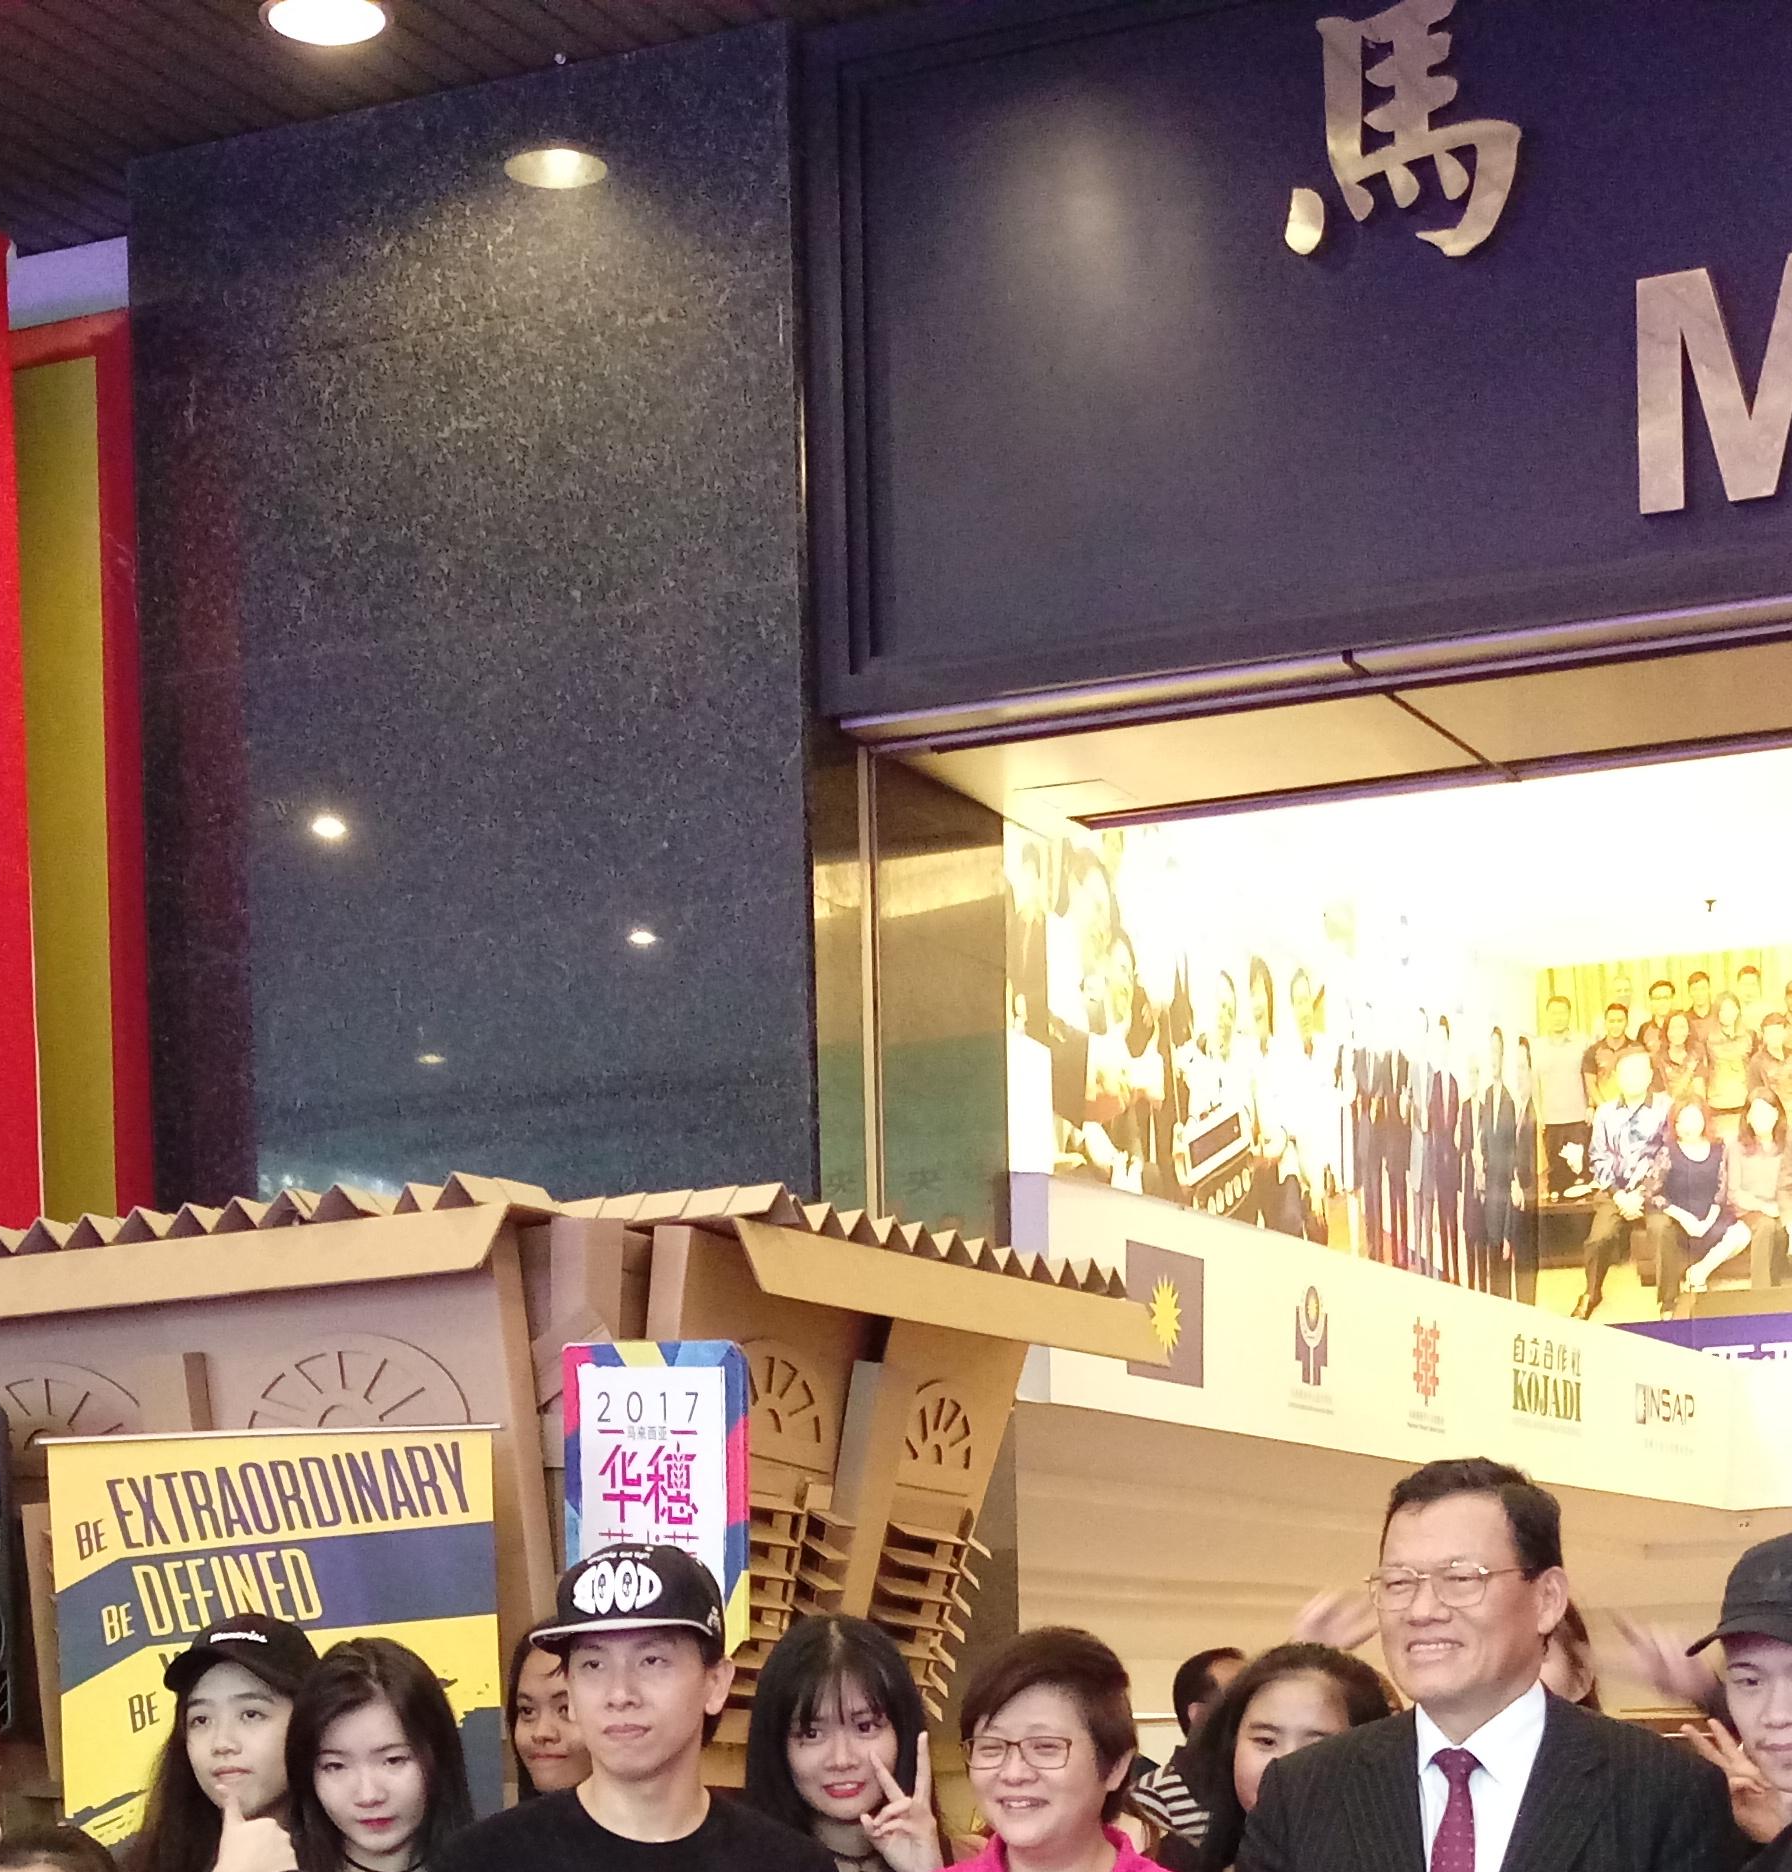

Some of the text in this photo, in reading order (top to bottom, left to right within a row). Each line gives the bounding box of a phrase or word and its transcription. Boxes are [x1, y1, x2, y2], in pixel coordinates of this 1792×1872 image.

[597, 1391, 699, 1423] 2017
[1513, 1368, 1581, 1422] KOJADI
[75, 1441, 470, 1561] BE EXTRAORDINARY
[598, 1441, 699, 1525] 华穗
[101, 1548, 323, 1646] BE DEFINED
[127, 1692, 160, 1734] BE
